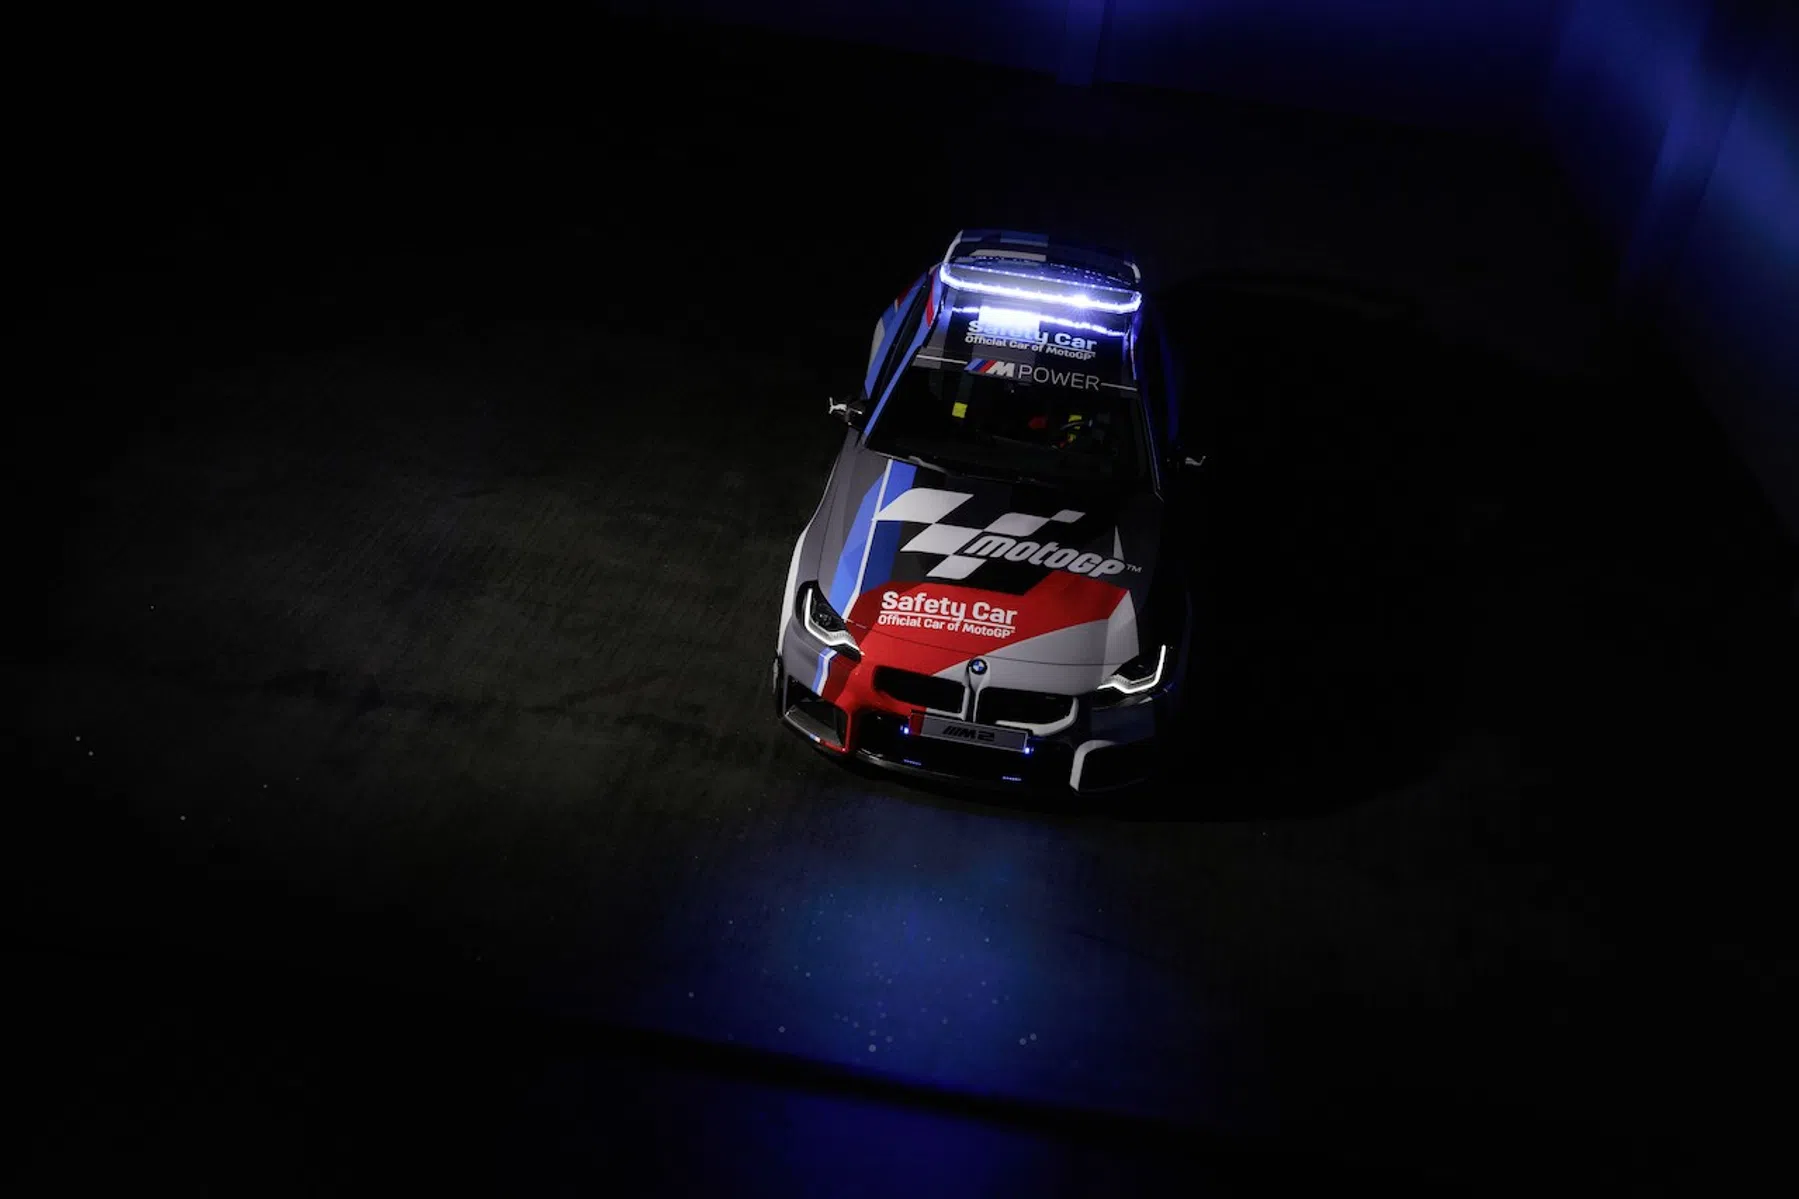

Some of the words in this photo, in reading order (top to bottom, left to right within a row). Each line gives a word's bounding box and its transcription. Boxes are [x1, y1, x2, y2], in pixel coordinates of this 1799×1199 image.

[965, 335, 1006, 347] Official
[1009, 340, 1029, 350] Car
[1031, 343, 1043, 353] of
[1055, 332, 1097, 351] Car
[1018, 365, 1099, 391] POWER
[882, 591, 966, 622] Safety
[972, 602, 1018, 624] Car
[878, 614, 921, 628] Official
[924, 619, 945, 631] Car
[947, 621, 961, 632] of
